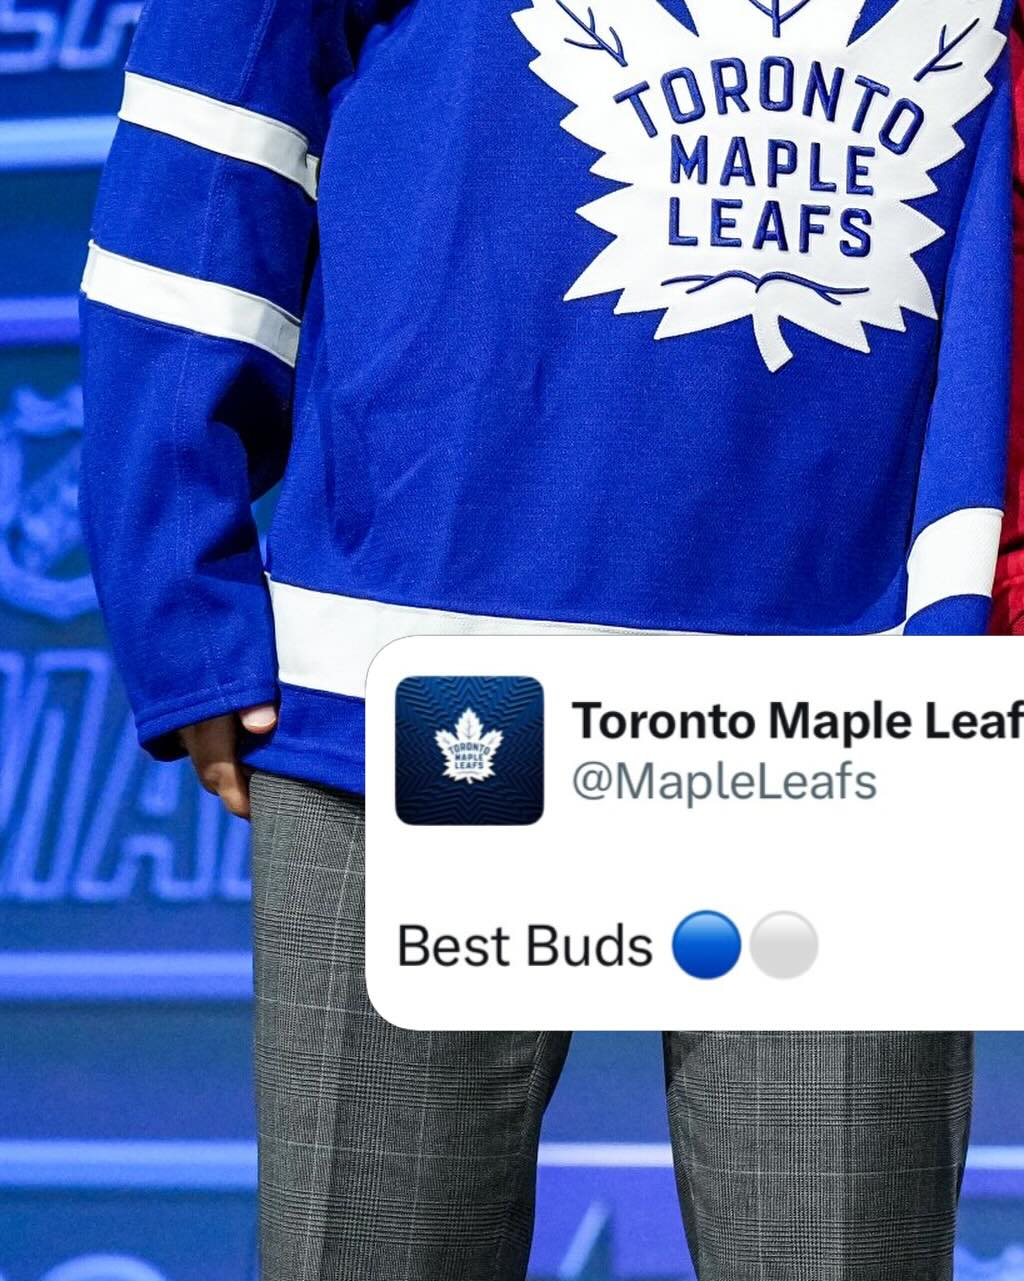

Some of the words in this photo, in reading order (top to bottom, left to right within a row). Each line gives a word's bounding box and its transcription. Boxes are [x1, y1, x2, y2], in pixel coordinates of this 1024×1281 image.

[613, 55, 925, 156] TORONTO
[669, 133, 876, 197] MAPLE
[668, 195, 873, 258] LEAFS
